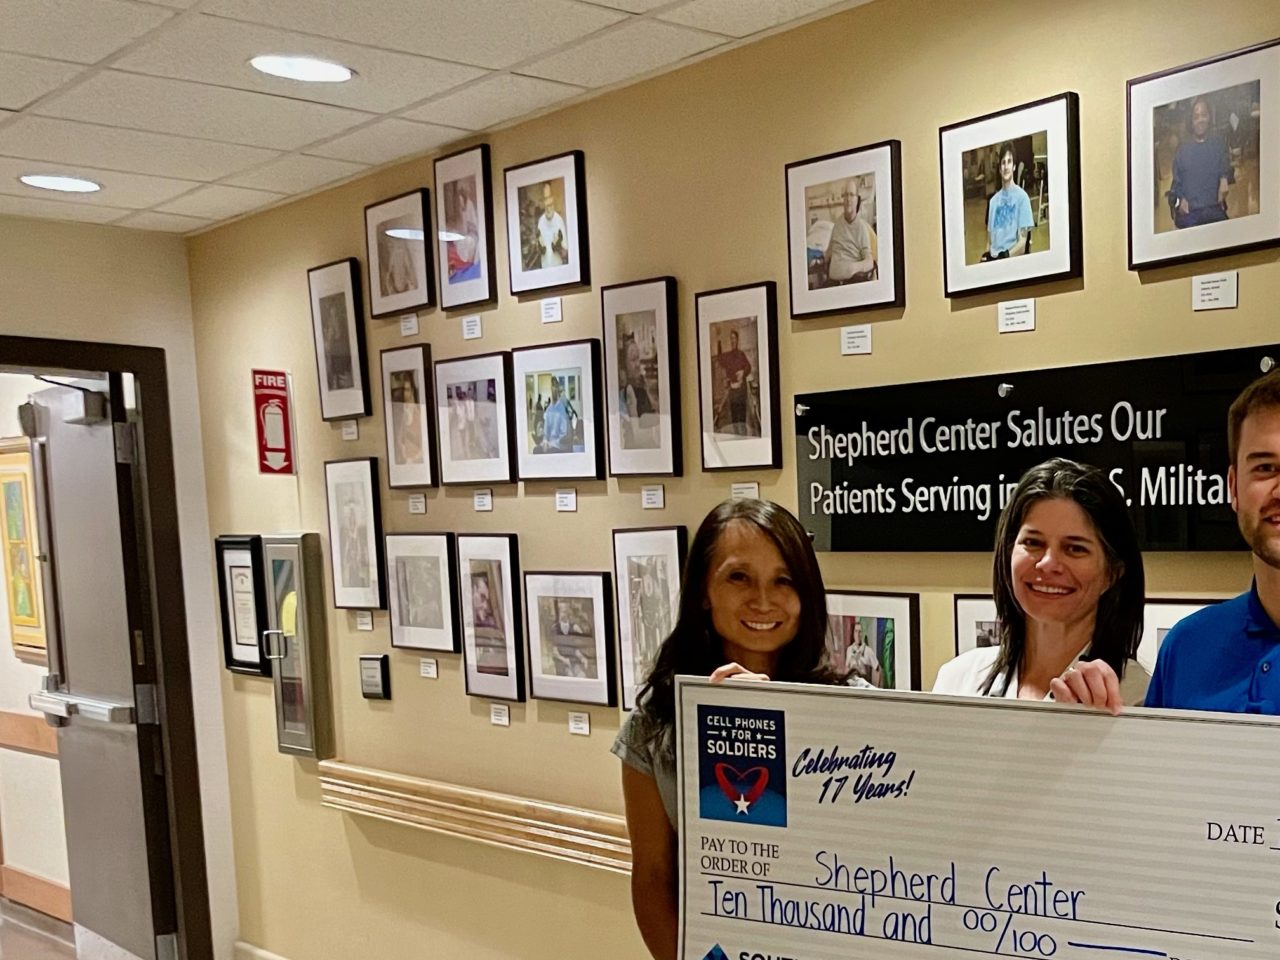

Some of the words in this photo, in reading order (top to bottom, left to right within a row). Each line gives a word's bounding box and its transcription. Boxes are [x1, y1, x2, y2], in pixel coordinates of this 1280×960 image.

[255, 374, 285, 387] FIRE
[808, 417, 914, 467] Shepherd
[919, 416, 1002, 453] Center
[1007, 405, 1103, 448] Salutes
[1110, 400, 1167, 442] Our
[810, 480, 896, 515] Patients
[901, 476, 991, 521] Serving
[1140, 463, 1232, 507] Milita
[707, 715, 732, 727] CELL
[735, 717, 776, 731] PHONES
[731, 729, 751, 740] FOR
[707, 739, 776, 759] SOLDIERS
[792, 744, 897, 778] Celebrating
[818, 776, 849, 804] 17
[853, 770, 915, 804] Years!
[1207, 822, 1265, 845] DATE
[700, 836, 726, 854] PAY
[728, 838, 749, 856] TO
[750, 842, 780, 860] THE
[700, 855, 749, 874] ORDER
[751, 861, 771, 877] OF
[815, 850, 956, 909] Shepherd
[984, 866, 1086, 921] Center
[708, 881, 747, 918] Ten
[756, 885, 866, 936] Thousand
[882, 903, 932, 946] and
